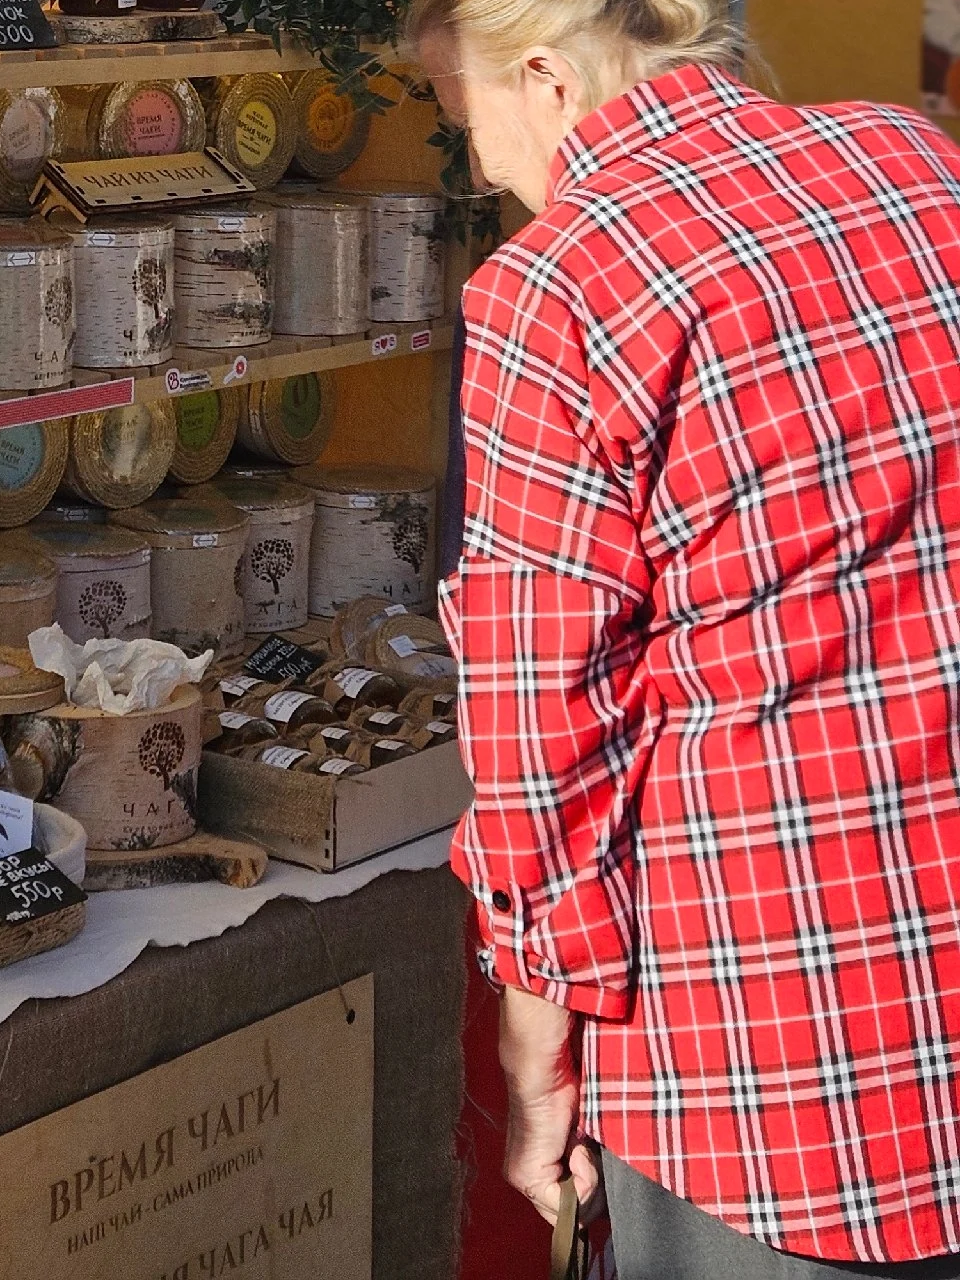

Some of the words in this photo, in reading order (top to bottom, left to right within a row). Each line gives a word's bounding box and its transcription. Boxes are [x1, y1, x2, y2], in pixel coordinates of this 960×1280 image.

[83, 171, 131, 188] ЧАЙ
[128, 170, 160, 185] ИЗ
[156, 165, 214, 182] ЧАГИ
[6, 860, 55, 885] ВКУСЫ
[46, 1126, 176, 1226] ВРЕМЯ
[186, 1076, 283, 1151] ЧАГИ
[66, 1222, 108, 1256] НАШ
[109, 1202, 144, 1240] ЧАЙ
[152, 1181, 195, 1217] САМА
[194, 1146, 266, 1195] ПРИРОДА
[277, 1186, 336, 1241] ЧАЯ
